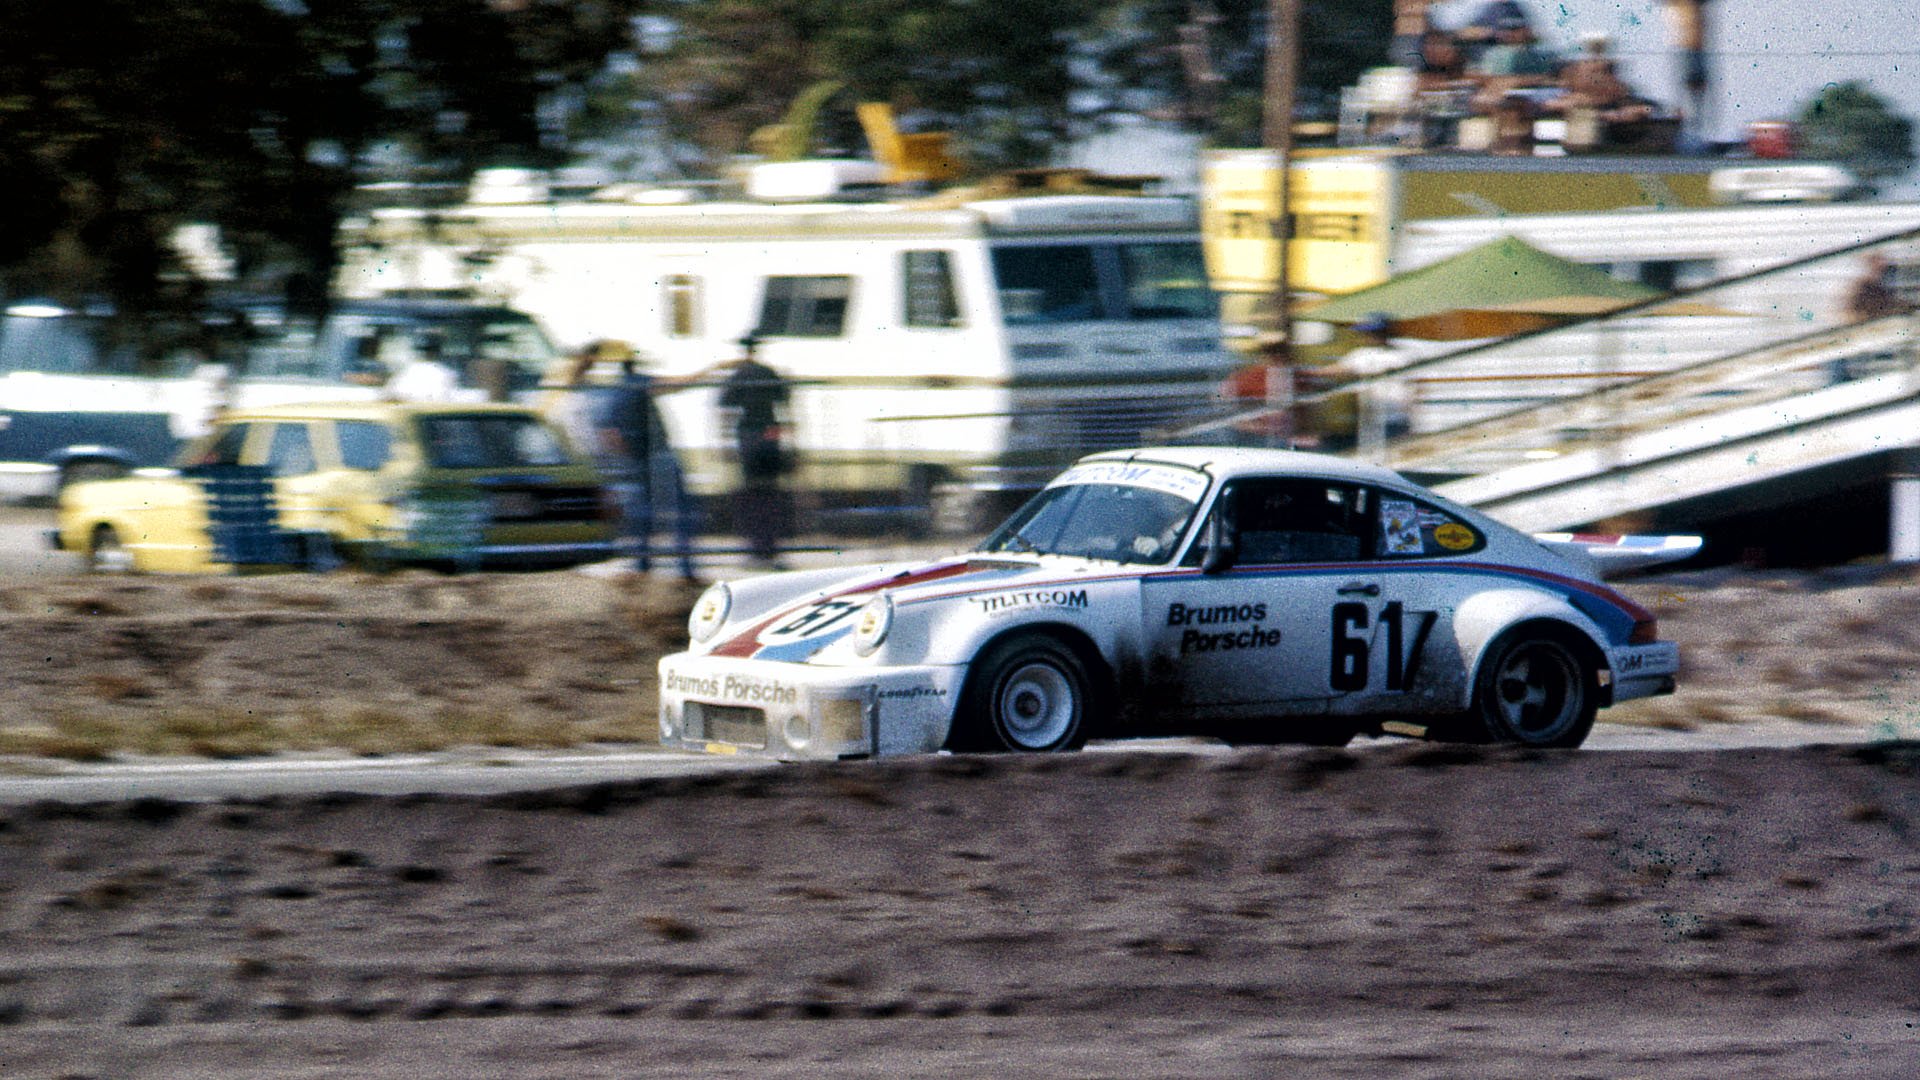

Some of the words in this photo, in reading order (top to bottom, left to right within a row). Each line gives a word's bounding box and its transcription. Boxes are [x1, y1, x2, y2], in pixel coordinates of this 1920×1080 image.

[1166, 603, 1268, 626] Brumos
[1180, 625, 1281, 654] Porsche
[666, 668, 719, 697] Brumos
[724, 675, 797, 704] Porsche
